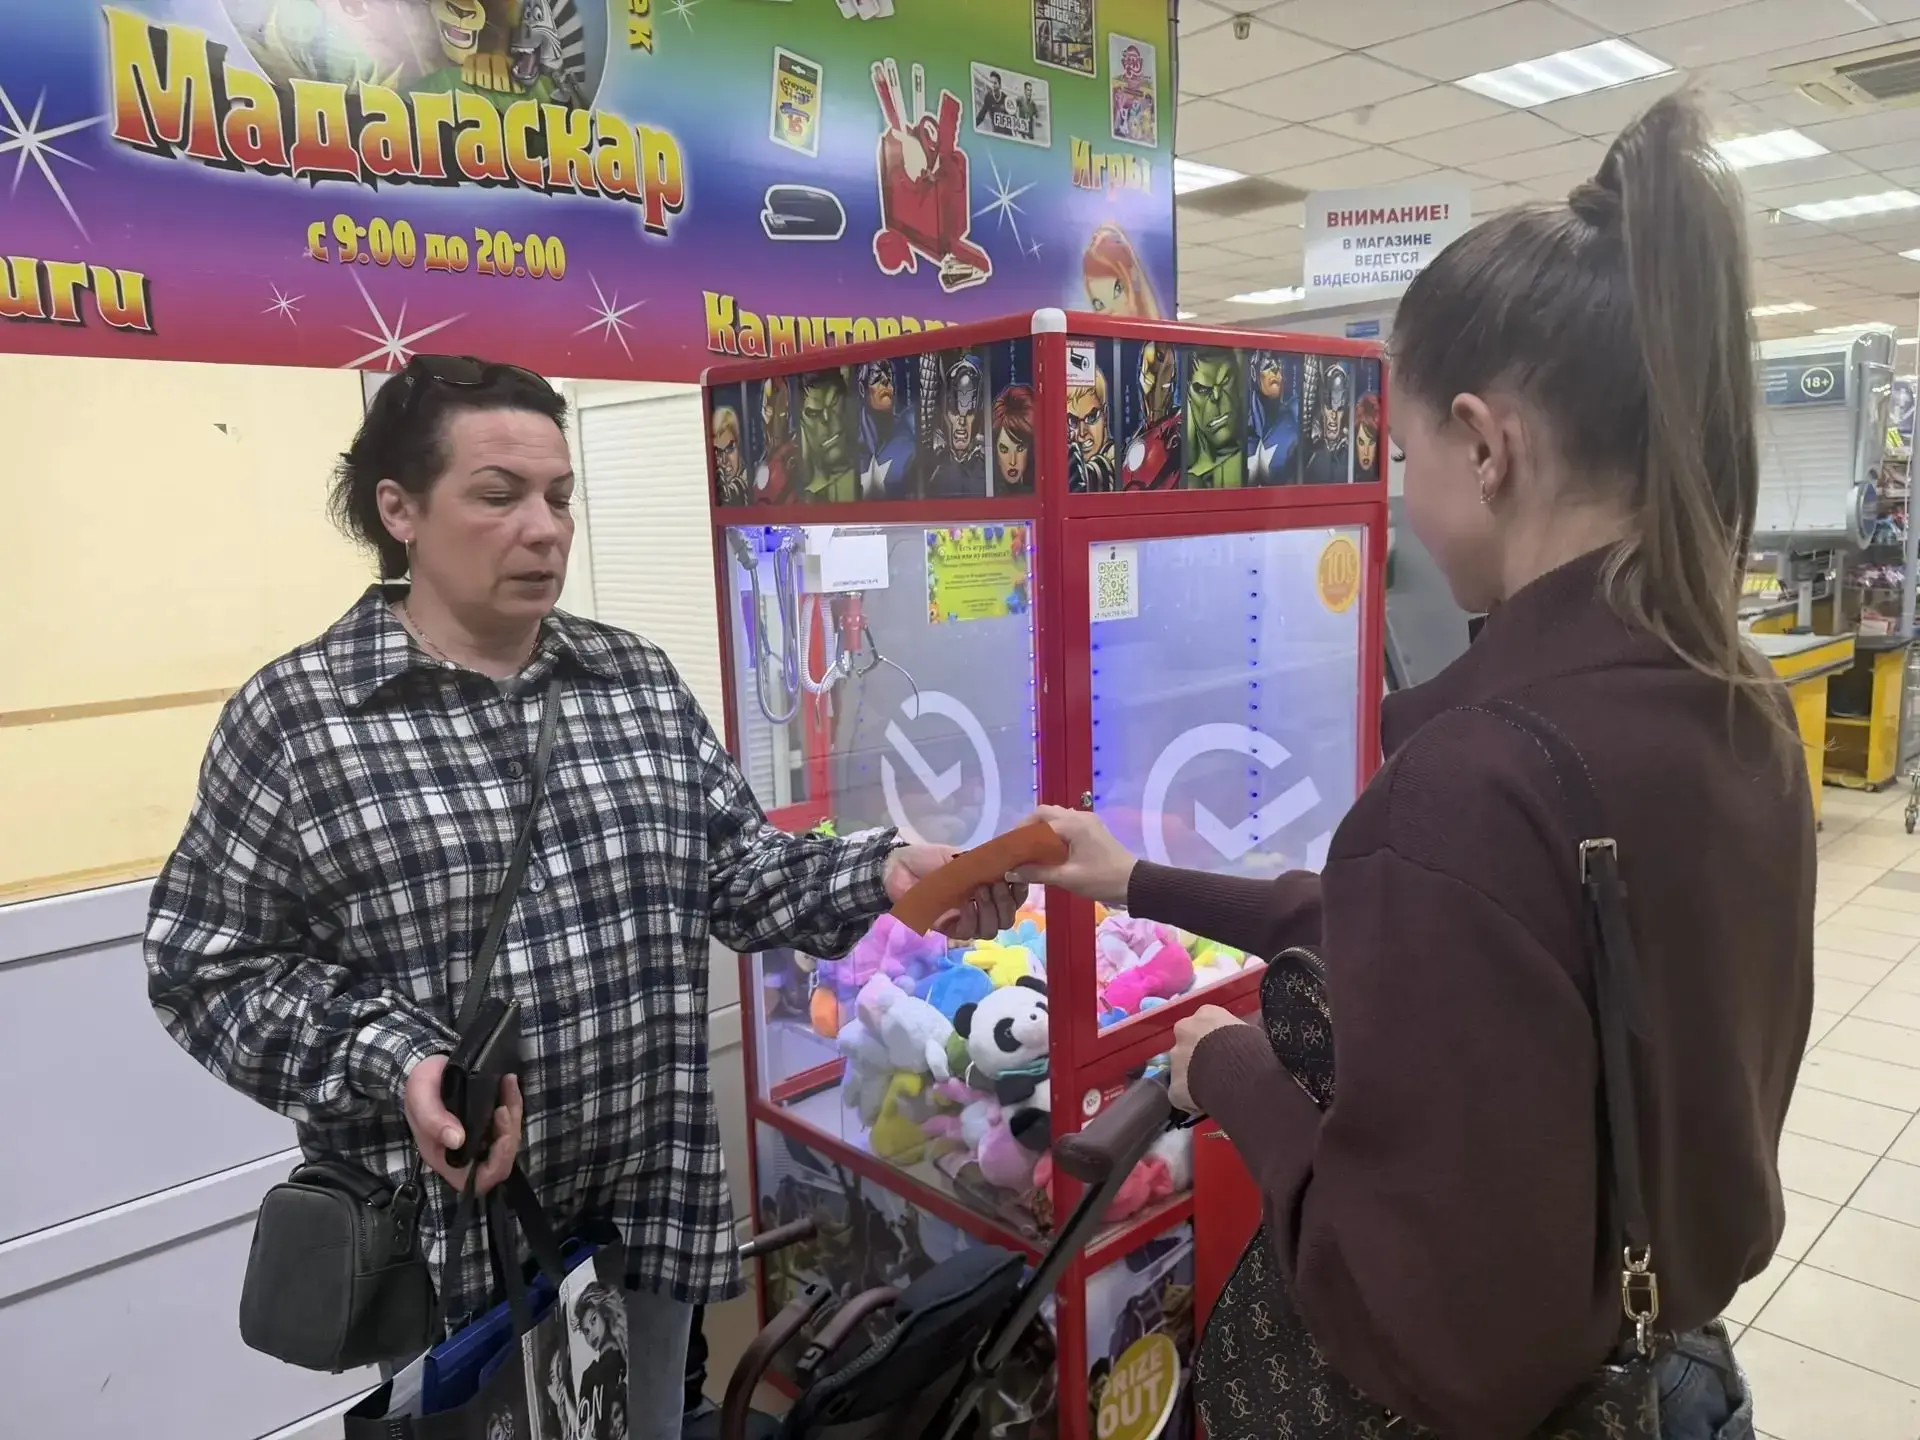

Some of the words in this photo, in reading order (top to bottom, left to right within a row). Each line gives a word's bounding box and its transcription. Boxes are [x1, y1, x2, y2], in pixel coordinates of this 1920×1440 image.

[103, 8, 687, 236] Мадагаскар
[1070, 135, 1153, 203] Игры
[1327, 204, 1449, 228] ВНИМАНИЕ!
[307, 221, 329, 262] с
[332, 213, 417, 268] 9:00
[424, 233, 469, 273] до
[474, 226, 567, 281] 20:00
[1343, 238, 1351, 250] В
[1356, 233, 1432, 249] МАГАЗИНЕ
[1355, 251, 1419, 268] ВЕДЕТСЯ
[1805, 376, 1829, 388] 18+
[1098, 1372, 1162, 1440] OUT
